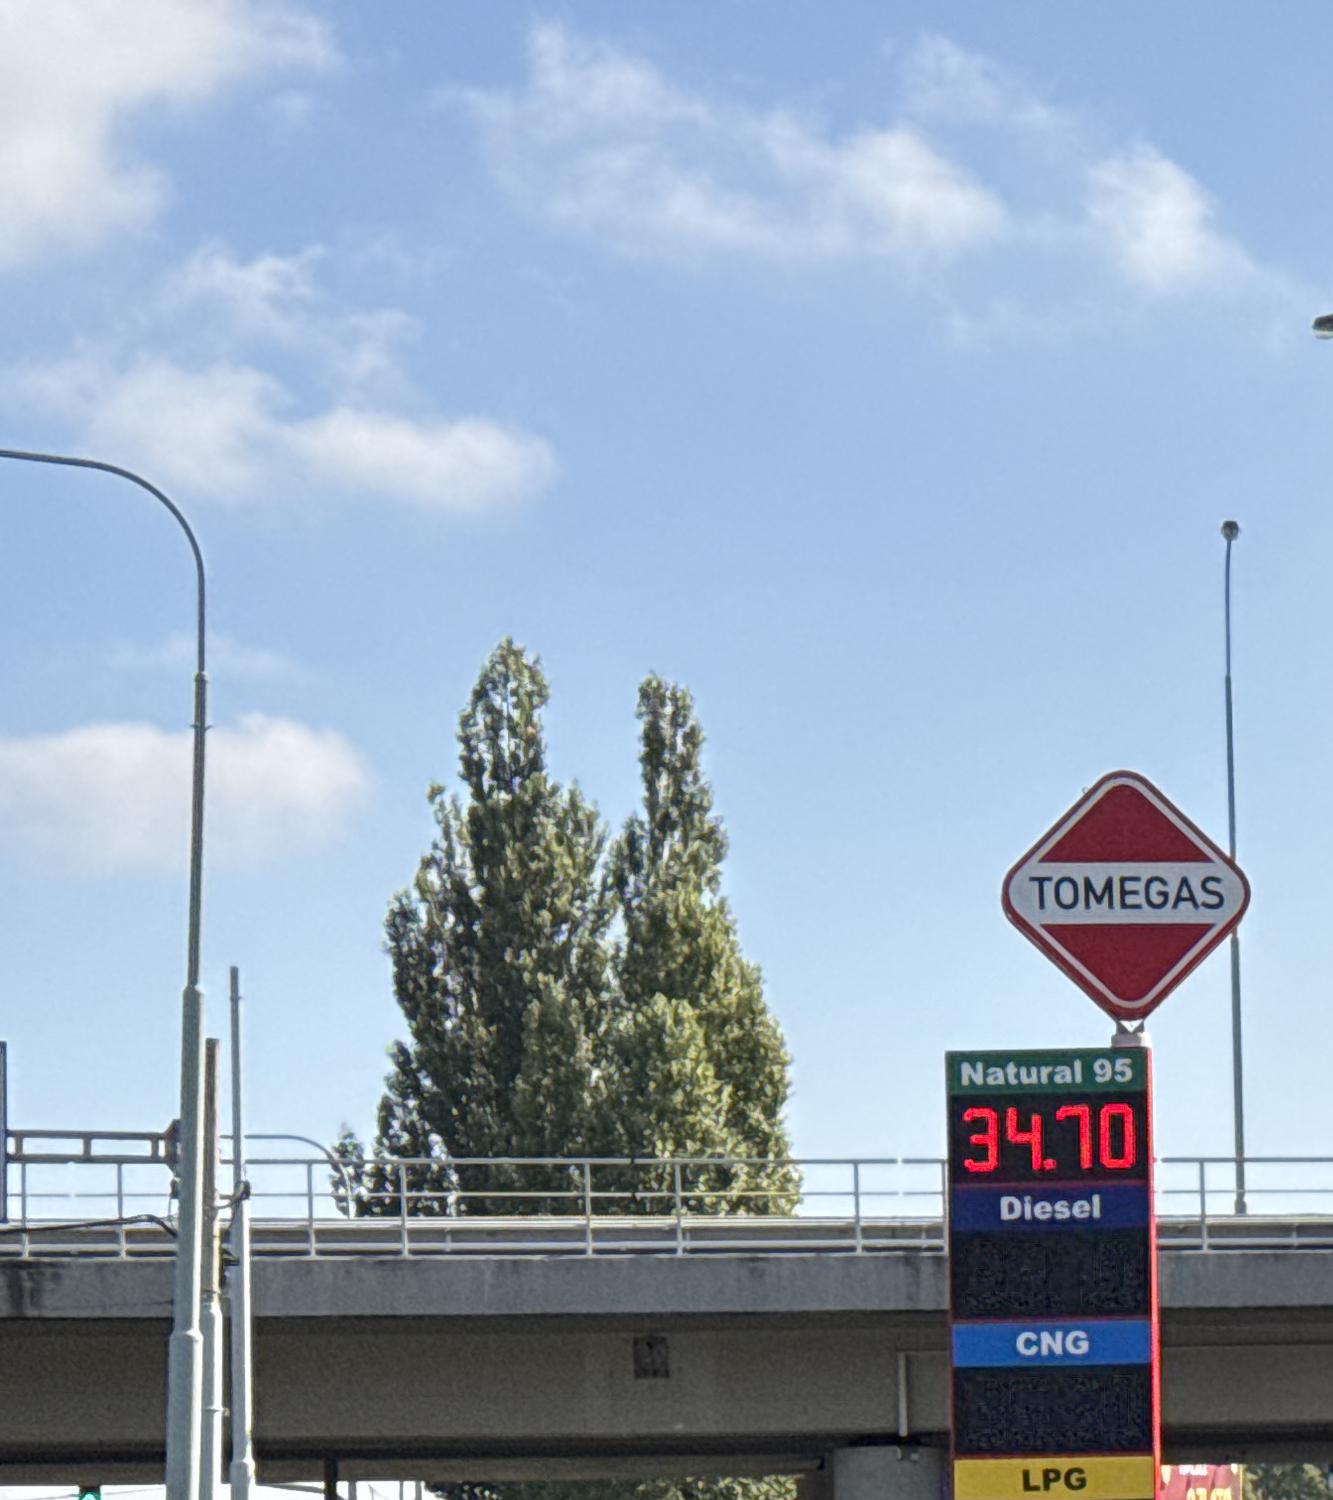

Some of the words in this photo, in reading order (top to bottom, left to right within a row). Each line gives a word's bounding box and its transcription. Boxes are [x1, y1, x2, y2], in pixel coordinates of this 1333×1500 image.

[1029, 875, 1225, 910] TOMEGAS
[960, 1059, 1082, 1086] Natural
[1093, 1057, 1134, 1084] 95
[962, 1103, 1137, 1173] 34.70
[999, 1194, 1101, 1221] Diesel
[1015, 1330, 1091, 1357] CNG
[1021, 1467, 1088, 1492] LPG
